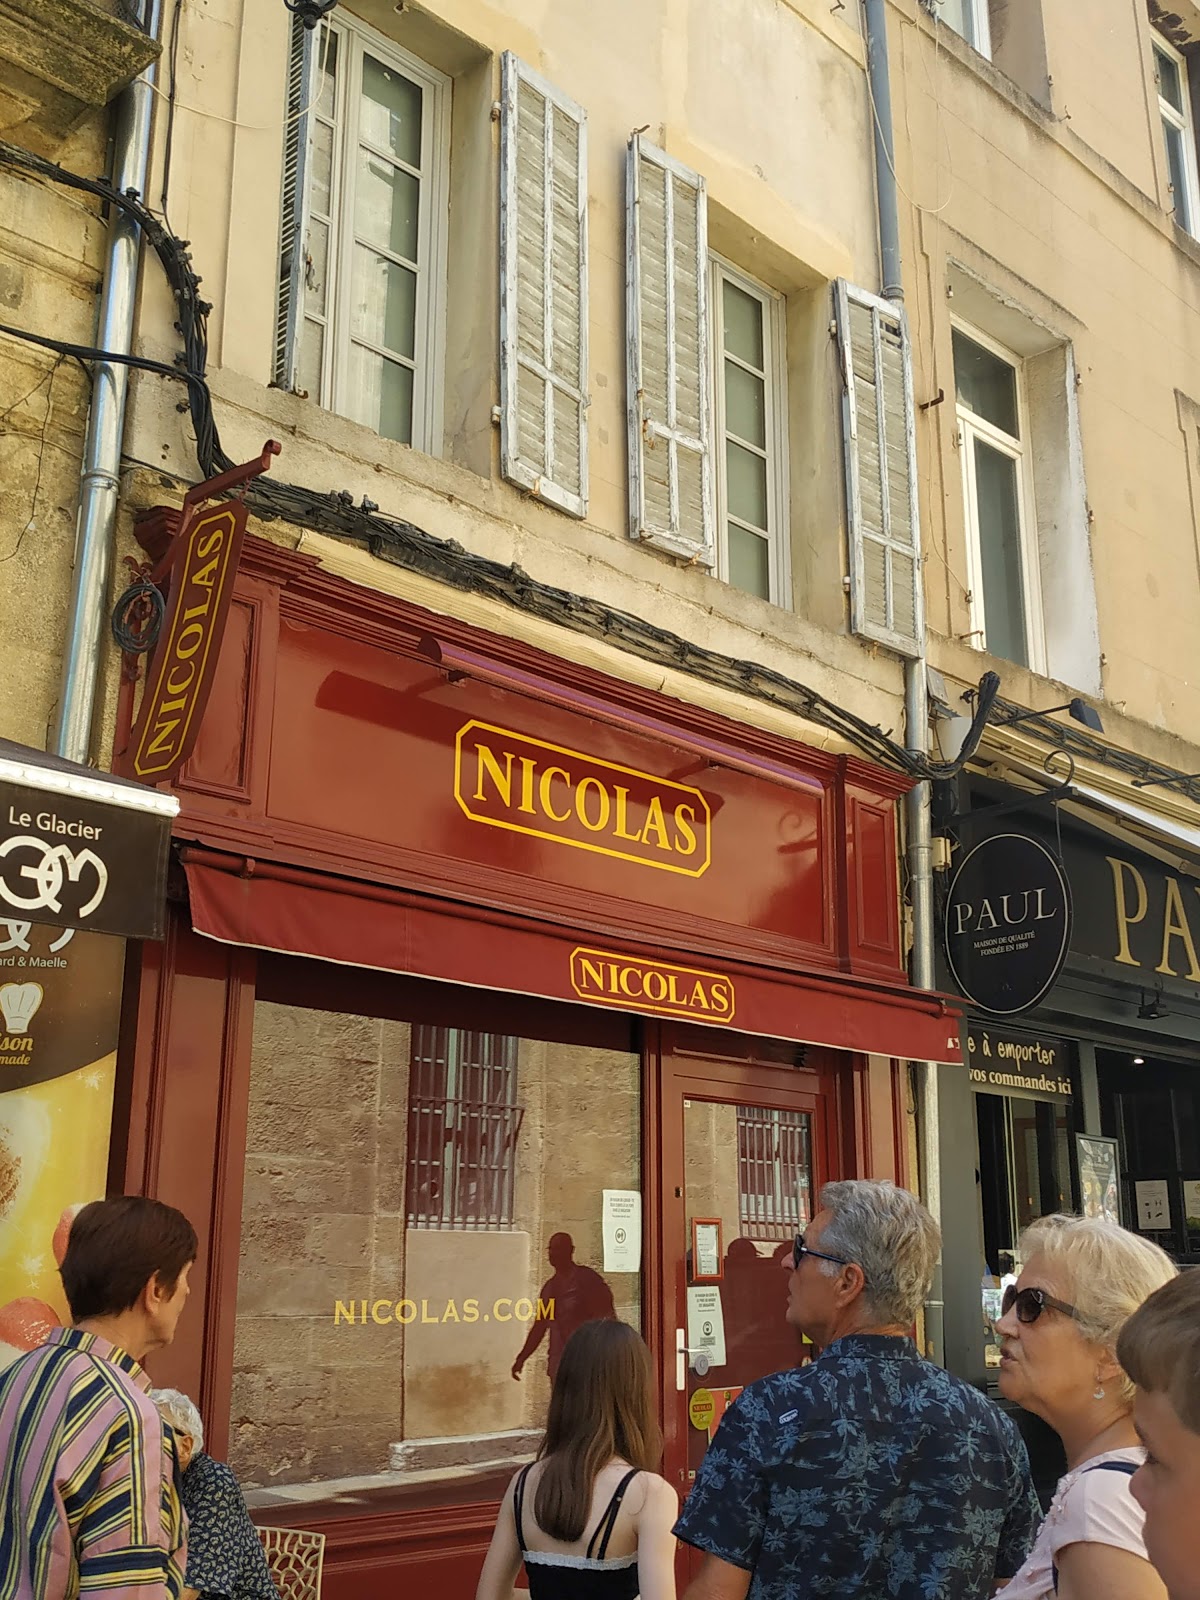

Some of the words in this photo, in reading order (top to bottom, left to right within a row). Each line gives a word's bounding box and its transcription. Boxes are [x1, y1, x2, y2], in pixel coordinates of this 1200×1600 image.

[146, 528, 224, 759] NICOLAS
[473, 743, 697, 855] NICOLAS
[9, 806, 32, 827] Le
[36, 813, 103, 840] Glacier
[953, 887, 1058, 935] PAUL
[1105, 856, 1200, 982] PA
[974, 938, 998, 949] MAISON
[999, 936, 1008, 944] DE
[1008, 930, 1036, 943] QUALITÉ
[981, 945, 1005, 956] FONDÉE
[1006, 944, 1015, 952] EN
[18, 956, 27, 967] &
[29, 956, 68, 968] Maelle
[578, 957, 729, 1012] NICOLAS
[982, 1032, 992, 1057] à
[998, 1041, 1056, 1071] emporter
[989, 1071, 1057, 1092] commandes
[1058, 1076, 1073, 1095] ici
[334, 1298, 556, 1325] NICOLAS.COM
